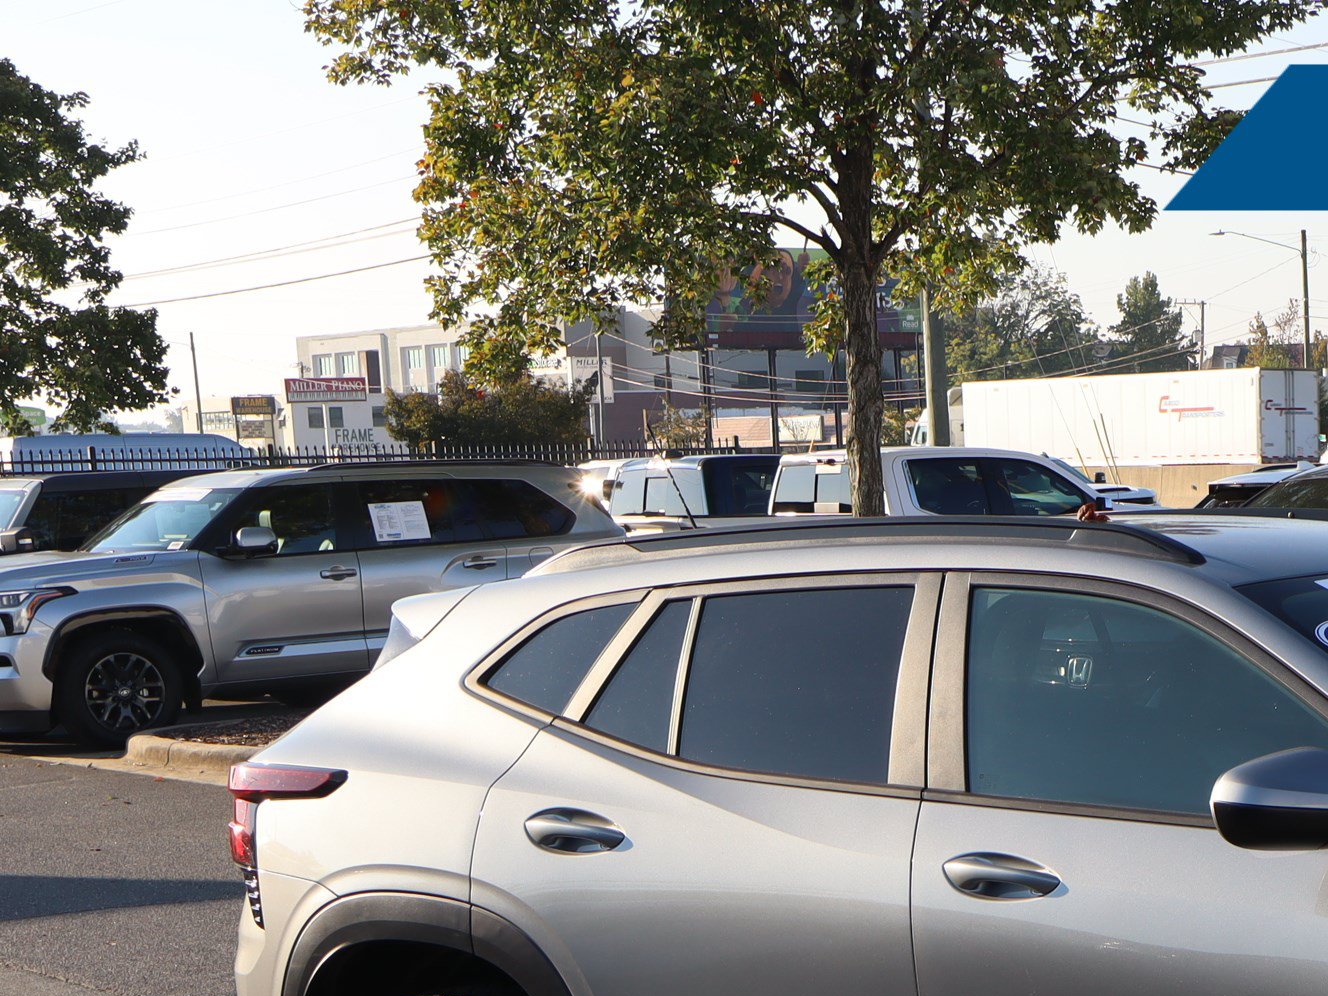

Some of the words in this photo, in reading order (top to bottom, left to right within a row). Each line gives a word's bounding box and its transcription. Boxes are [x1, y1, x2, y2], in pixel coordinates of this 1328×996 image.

[577, 358, 607, 366] MILLR
[289, 380, 328, 392] MILLER
[331, 380, 363, 391] PIANO
[239, 398, 268, 407] FRAME
[335, 428, 374, 443] FRAME
